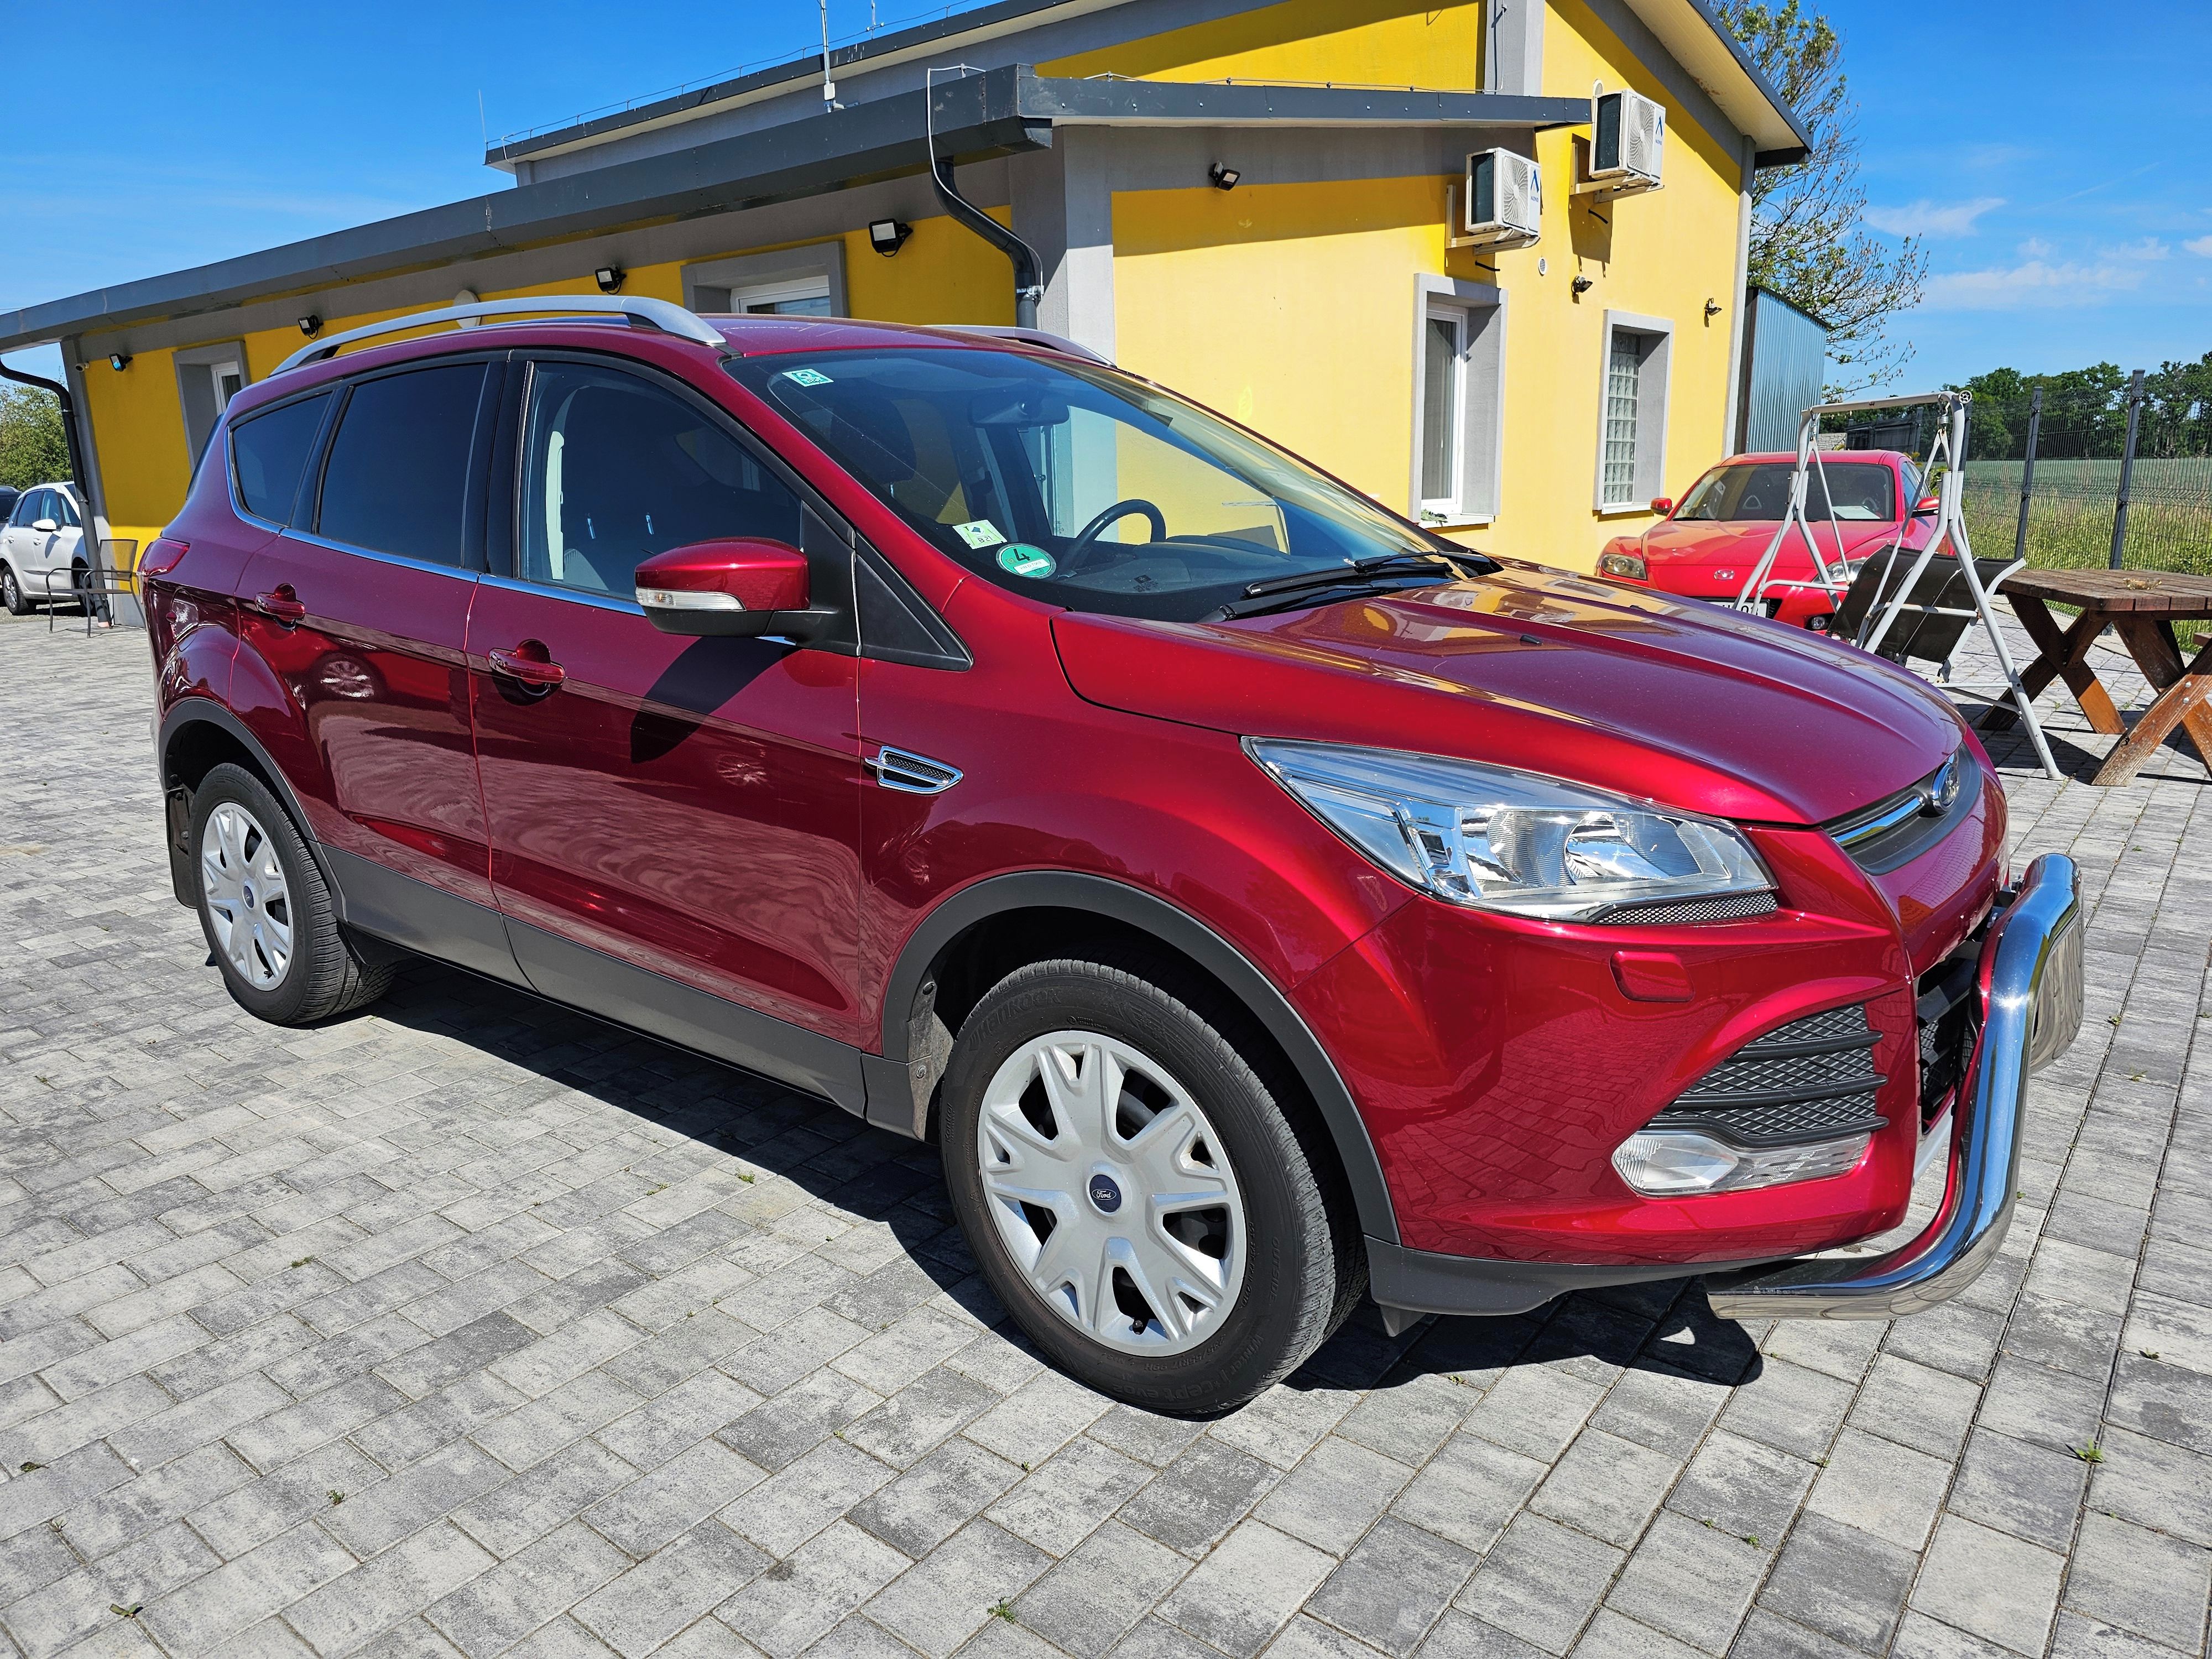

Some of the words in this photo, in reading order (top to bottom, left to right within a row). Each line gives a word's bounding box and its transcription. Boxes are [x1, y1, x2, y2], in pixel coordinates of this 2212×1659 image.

[1013, 548, 1031, 561] 4
[1096, 1190, 1112, 1198] Ford
[1267, 1235, 1280, 1304] OUTSIDE
